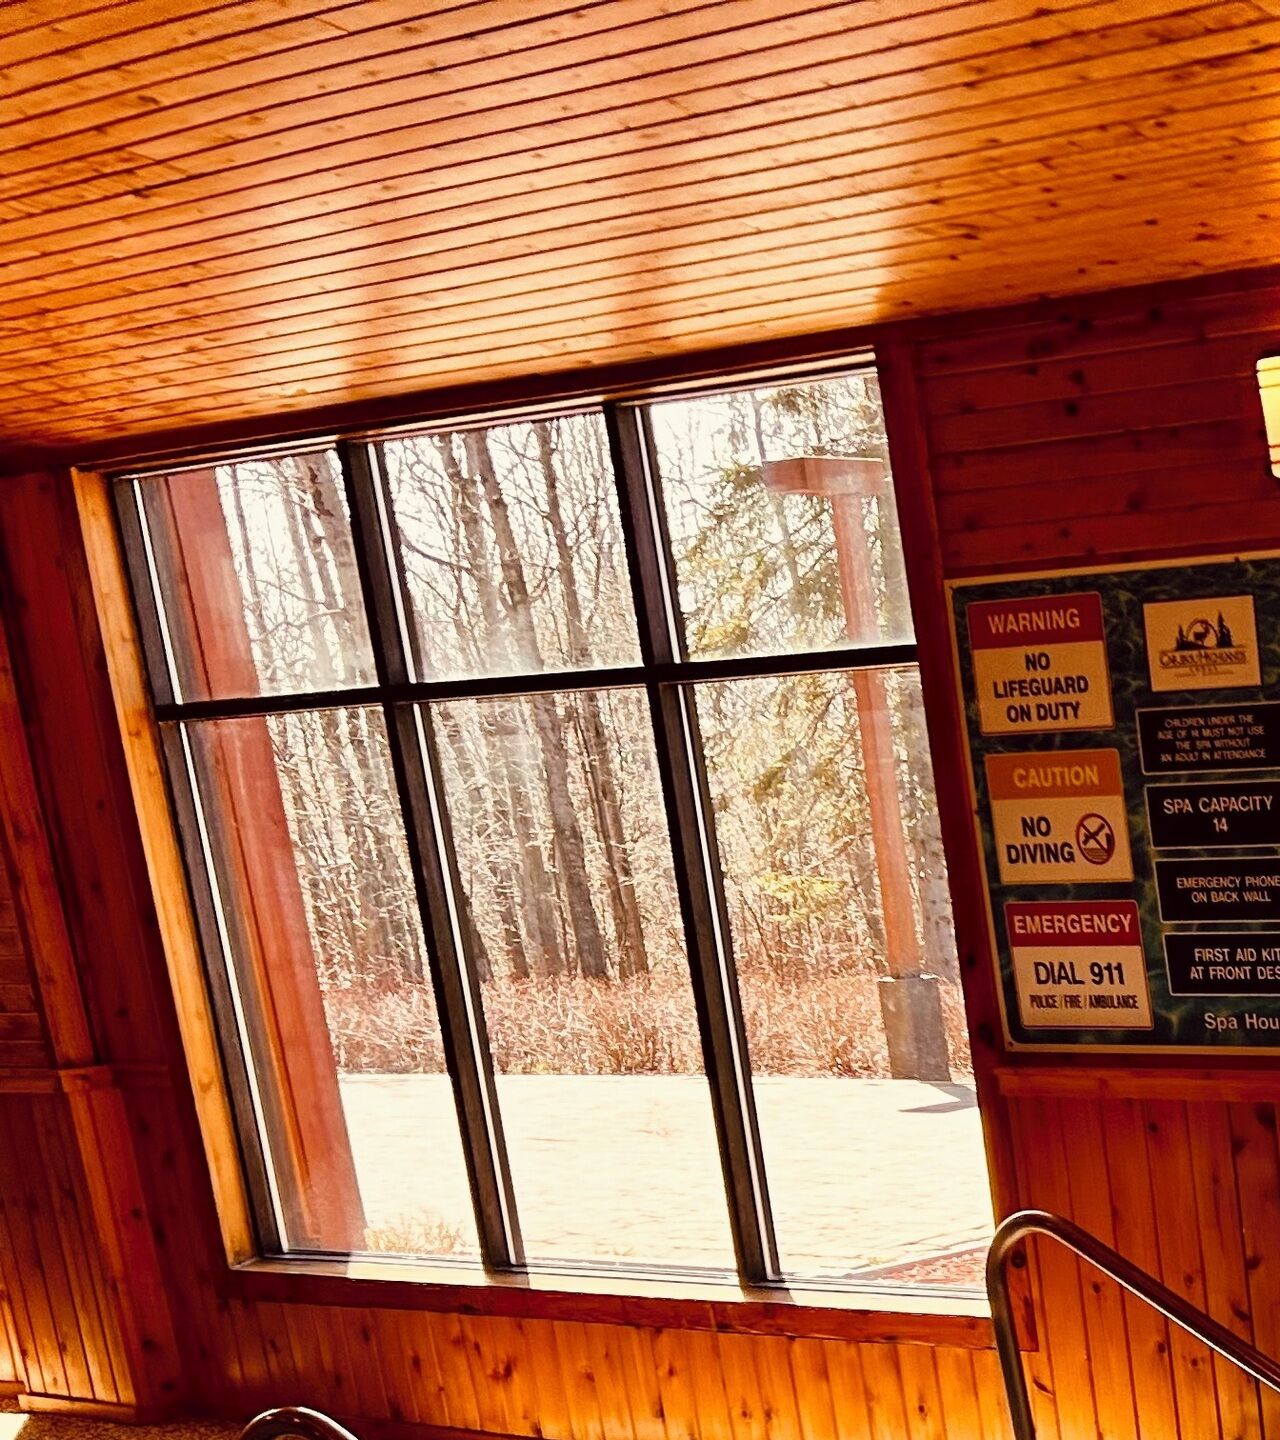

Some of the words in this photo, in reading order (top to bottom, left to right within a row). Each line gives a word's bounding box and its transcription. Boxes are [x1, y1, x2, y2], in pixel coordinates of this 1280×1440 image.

[988, 608, 1080, 634] WARNING
[1024, 652, 1050, 672] NO
[992, 675, 1089, 699] LIFEGUARD
[1006, 703, 1032, 723] ON
[1035, 700, 1081, 721] DUTY
[1014, 765, 1099, 788] CAUTION
[1163, 798, 1193, 814] SPA
[1198, 795, 1273, 813] CAPACITY
[1021, 816, 1051, 837] NO
[1213, 817, 1228, 832] 14
[1005, 842, 1076, 864] DIVING
[1176, 876, 1241, 889] EMERGENCY
[1191, 891, 1207, 903] ON
[1210, 891, 1239, 903] BACK
[1242, 891, 1271, 902] WALL
[1014, 914, 1131, 934] EMERGENCY
[1194, 948, 1230, 962] FIRST
[1236, 948, 1257, 961] AID
[1033, 961, 1086, 985] DIAL
[1089, 962, 1125, 985] 911
[1190, 966, 1204, 979] AT
[1209, 966, 1252, 980] FRONT
[1029, 994, 1059, 1009] POLICE
[1063, 994, 1083, 1009] FIRE
[1088, 994, 1139, 1009] AMBULANCE
[1204, 1012, 1238, 1032] Spa
